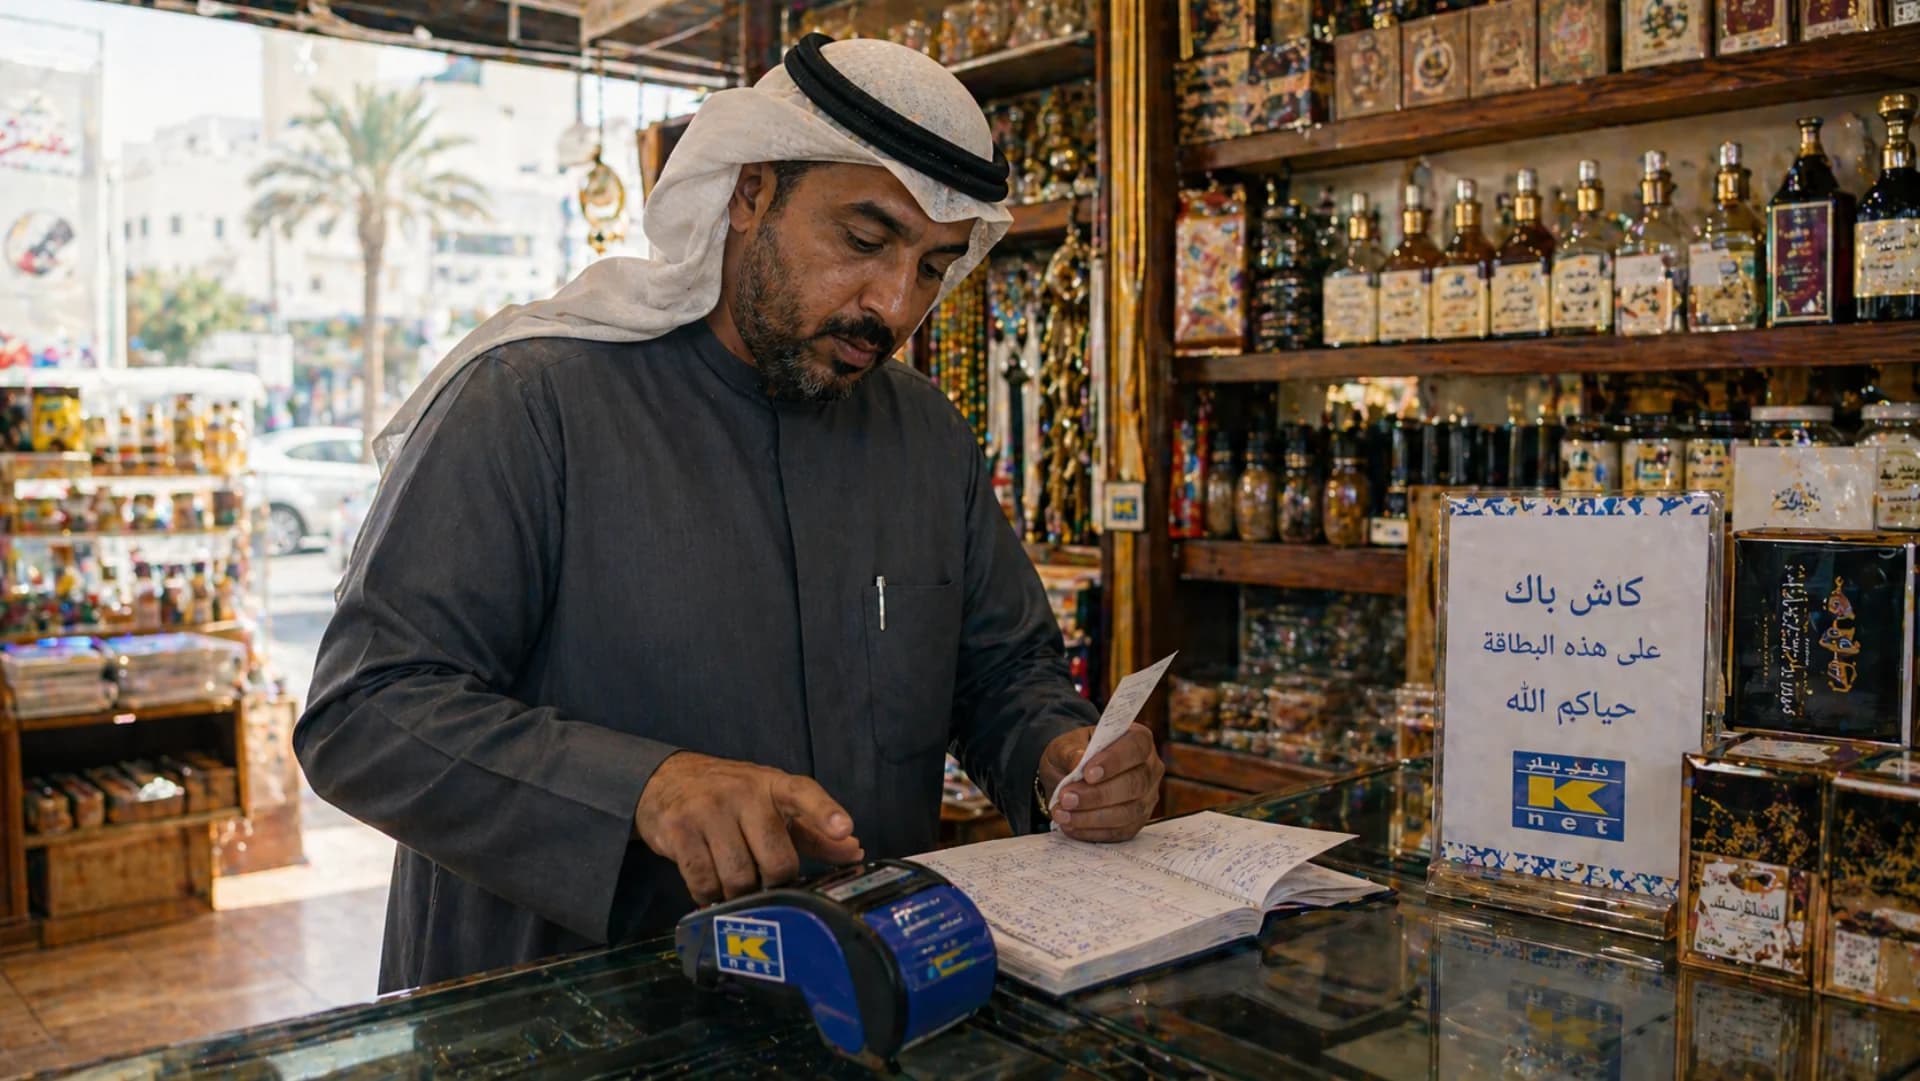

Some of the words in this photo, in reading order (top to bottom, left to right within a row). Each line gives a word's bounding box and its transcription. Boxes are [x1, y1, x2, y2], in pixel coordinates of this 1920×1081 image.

[1505, 574, 1556, 613] باك
[1570, 576, 1643, 616] كاش
[1483, 632, 1554, 660] البطاقة
[1564, 636, 1607, 658] هذه
[1617, 637, 1661, 666] على
[1506, 680, 1545, 713] الله
[1527, 775, 1608, 815] K
[1527, 812, 1608, 835] net
[727, 934, 769, 961] K
